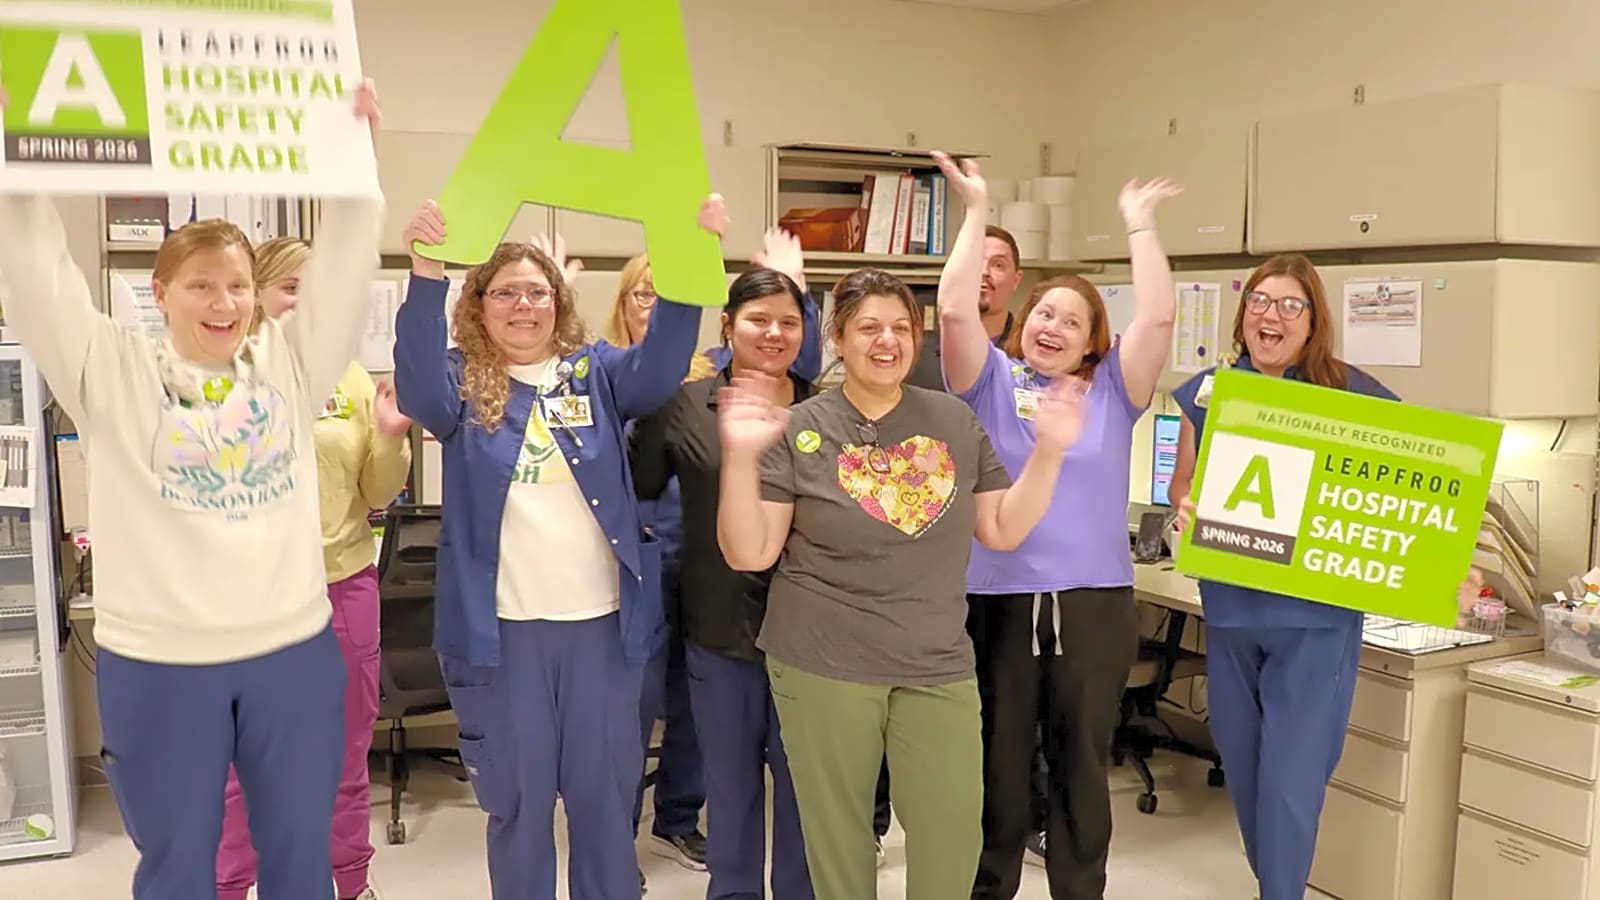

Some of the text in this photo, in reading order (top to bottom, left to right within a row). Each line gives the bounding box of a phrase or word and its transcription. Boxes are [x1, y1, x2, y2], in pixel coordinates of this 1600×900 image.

[157, 28, 340, 64] LEAPFROG
[28, 29, 128, 128] A
[162, 62, 350, 98] HOSPITAL
[164, 103, 304, 133] SAFETY
[18, 137, 138, 161] SPRING 2026
[168, 140, 309, 174] GRADE
[412, 0, 729, 306] A
[1256, 410, 1446, 457] NATIONALLY RECOGNIZED
[1223, 454, 1275, 519] A
[1324, 453, 1462, 497] LEAPFROG
[1318, 482, 1459, 533] HOSPITAL
[1200, 525, 1285, 555] SPRING 2026
[1309, 515, 1416, 557] SAFETY
[1303, 547, 1406, 589] GRADE
